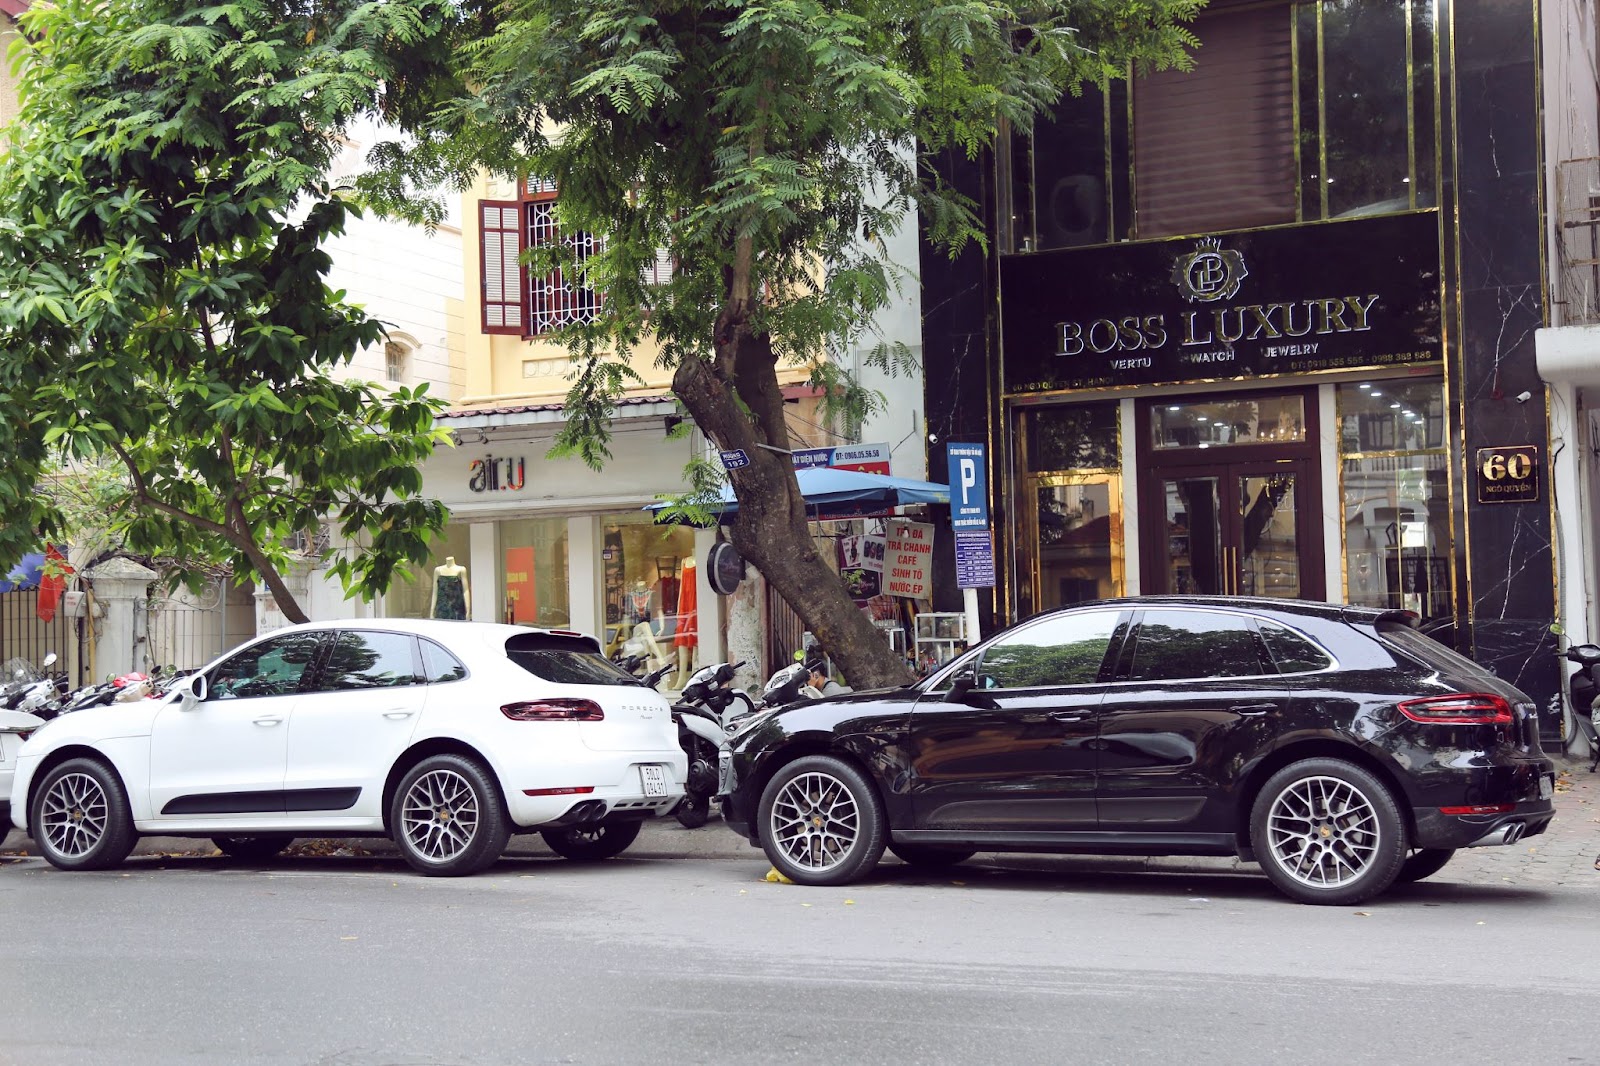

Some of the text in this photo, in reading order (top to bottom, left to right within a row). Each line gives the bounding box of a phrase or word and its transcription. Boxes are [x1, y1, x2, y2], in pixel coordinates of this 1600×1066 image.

[1054, 294, 1380, 356] BOSS LUXURY
[1110, 343, 1319, 370] VERTU WATCH JEWELRY
[727, 459, 745, 468] 192
[1483, 453, 1532, 481] 60
[960, 458, 976, 505] P
[903, 542, 931, 554] CHANH
[891, 568, 911, 578] SINH
[889, 581, 911, 593] NƯỚC
